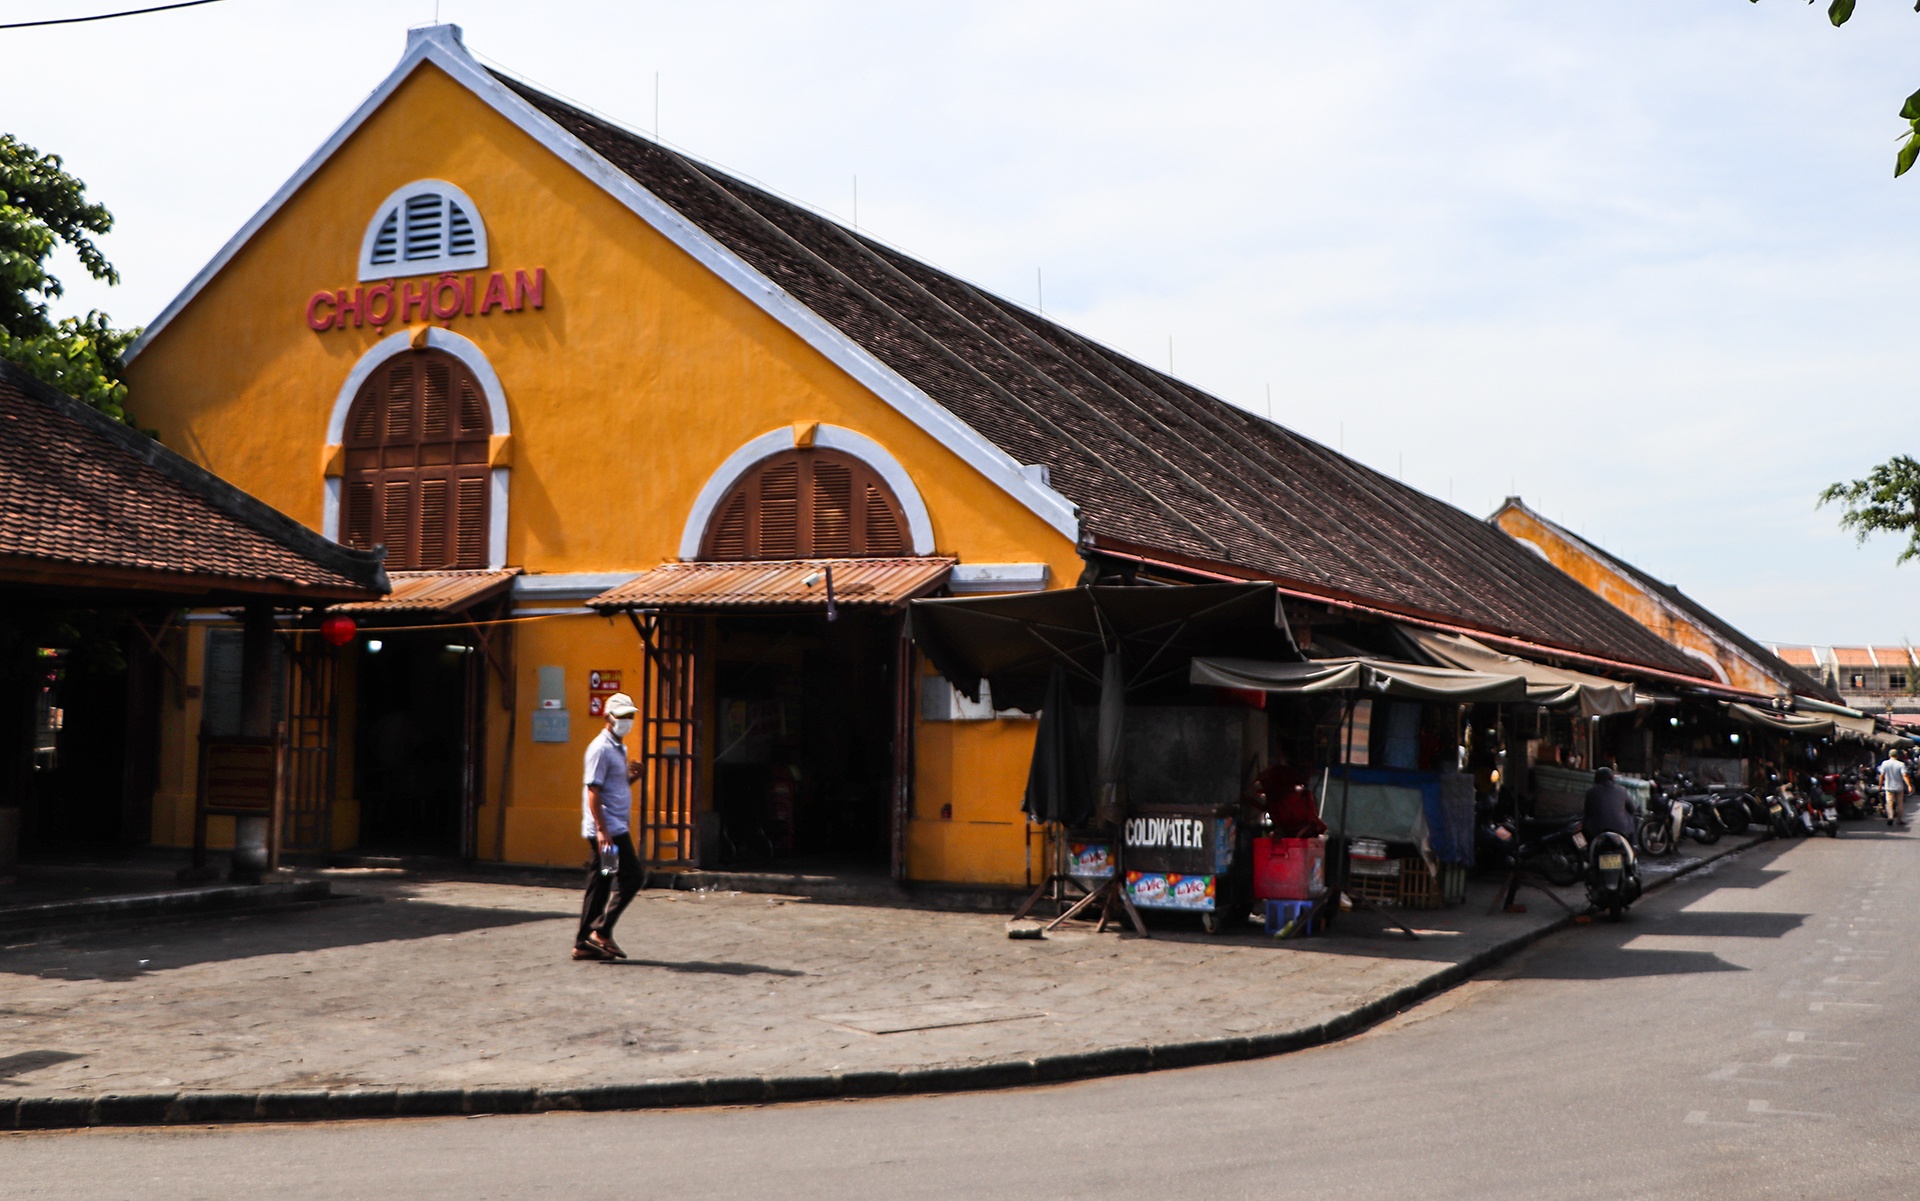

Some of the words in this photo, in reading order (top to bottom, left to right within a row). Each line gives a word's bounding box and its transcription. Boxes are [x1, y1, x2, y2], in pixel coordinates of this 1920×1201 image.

[306, 277, 395, 334] CHỢ
[402, 271, 475, 328] HỘI
[480, 265, 545, 312] AN
[1145, 877, 1164, 892] Vie
[1185, 880, 1204, 894] Vie
